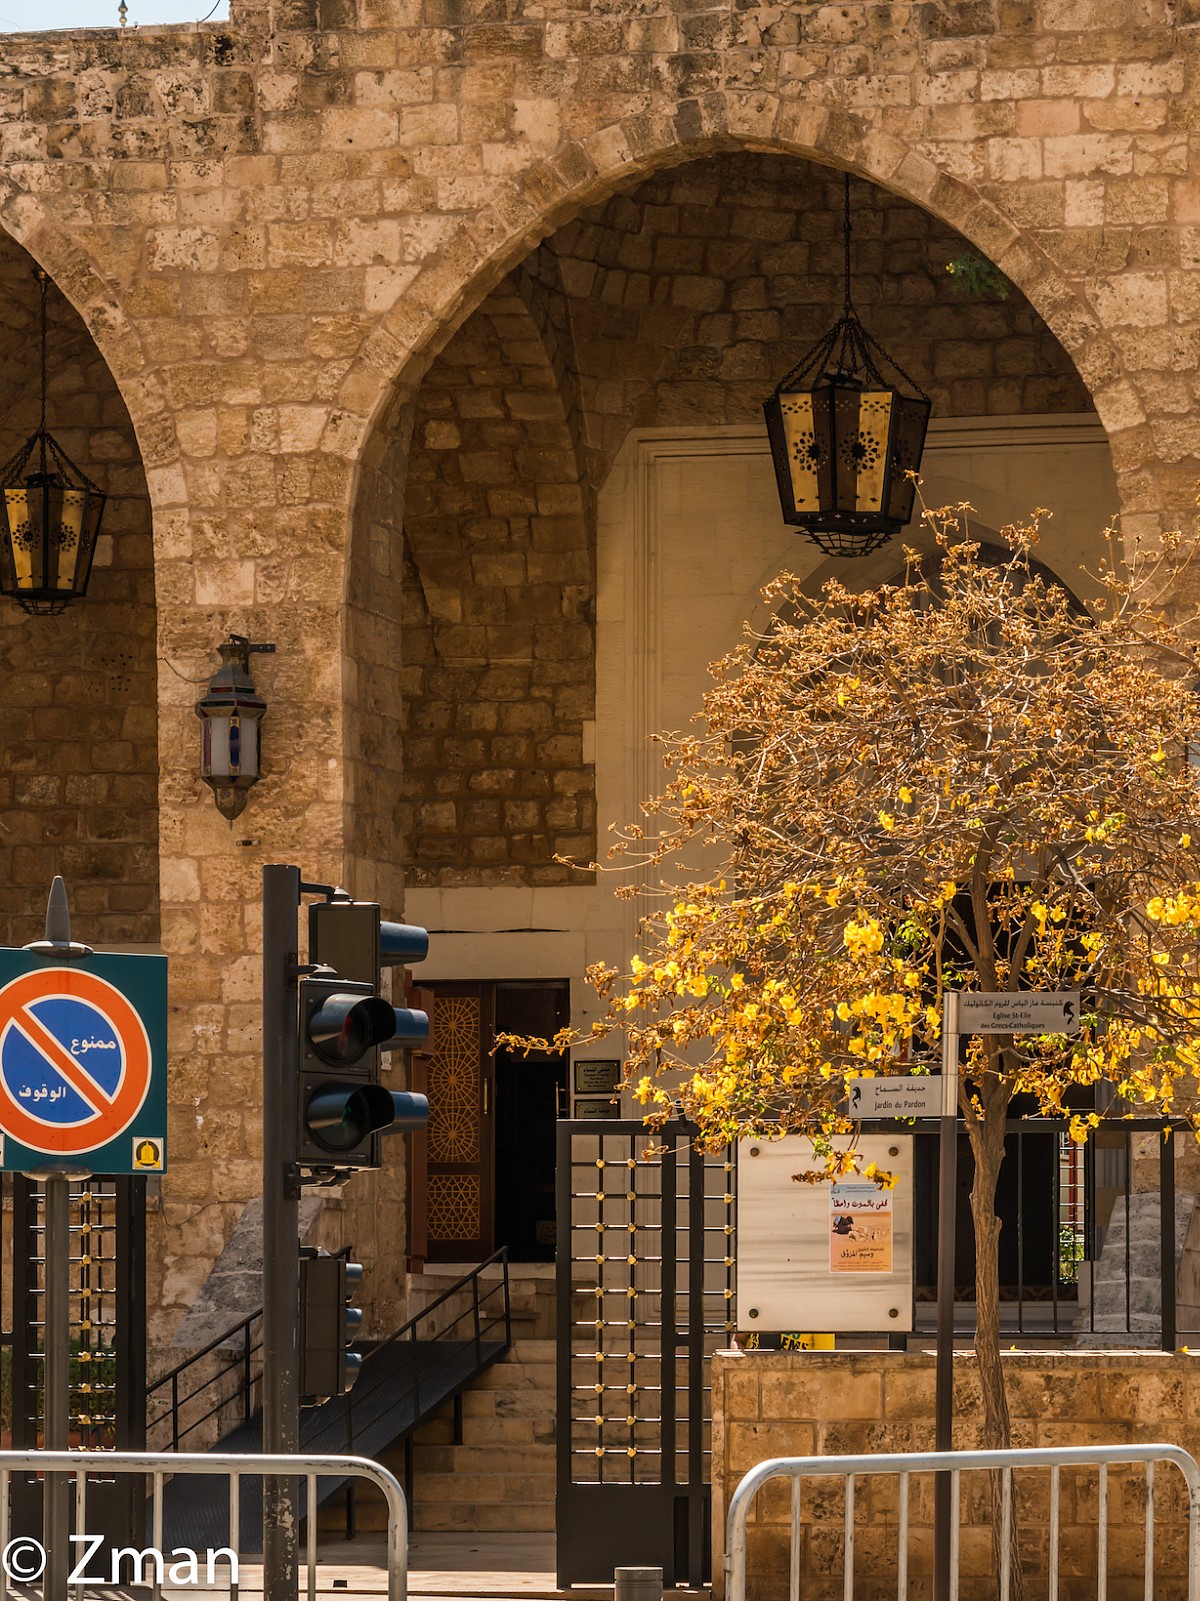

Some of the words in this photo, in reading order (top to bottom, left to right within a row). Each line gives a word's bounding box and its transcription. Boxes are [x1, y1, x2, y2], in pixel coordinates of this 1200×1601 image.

[994, 999, 1010, 1008] للروم
[992, 1012, 1011, 1020] Eglise
[990, 1022, 1045, 1030] Grecs-Catholiques
[70, 1036, 117, 1055] ممنوع
[18, 1083, 67, 1102] الوقوف
[875, 1084, 903, 1096] السماح
[906, 1083, 926, 1093] حديقة
[874, 1101, 893, 1111] Jardin
[903, 1100, 926, 1109] Pardon
